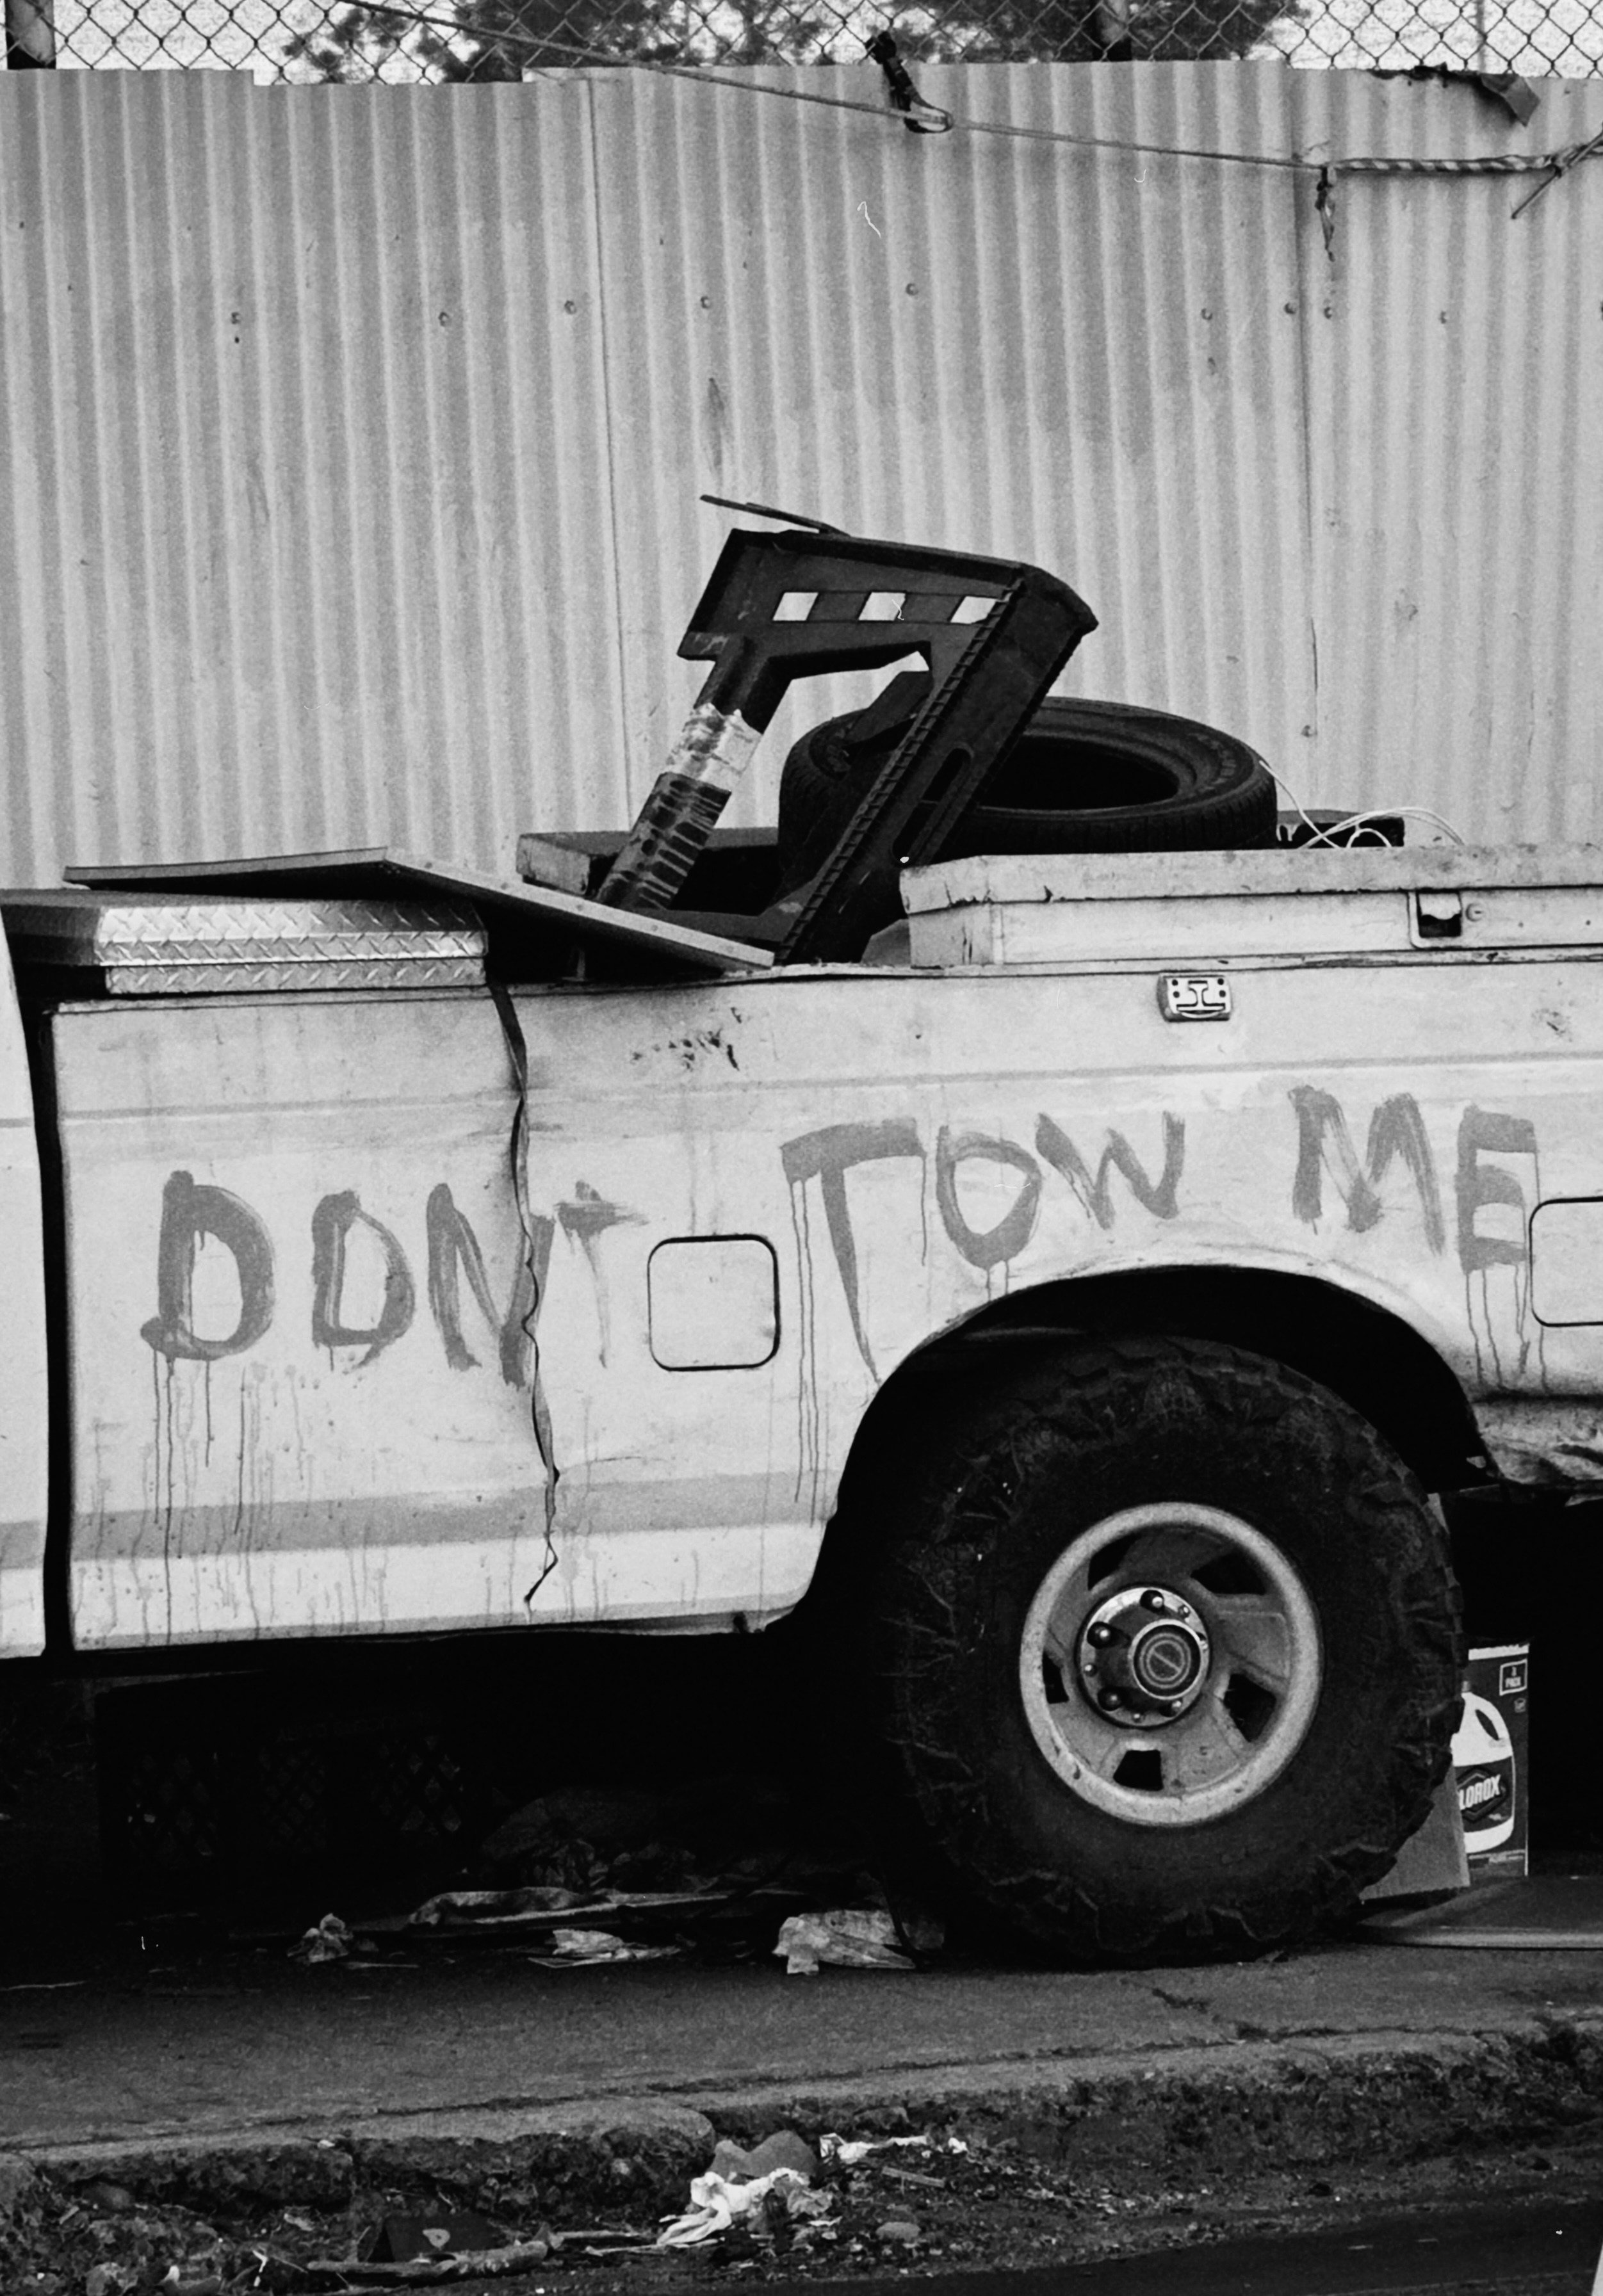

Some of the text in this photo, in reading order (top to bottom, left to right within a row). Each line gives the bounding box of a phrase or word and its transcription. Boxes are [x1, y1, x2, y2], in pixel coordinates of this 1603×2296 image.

[779, 1110, 1185, 1387] TOW
[1287, 1085, 1540, 1275] ME
[1458, 1774, 1501, 1811] LOROX
